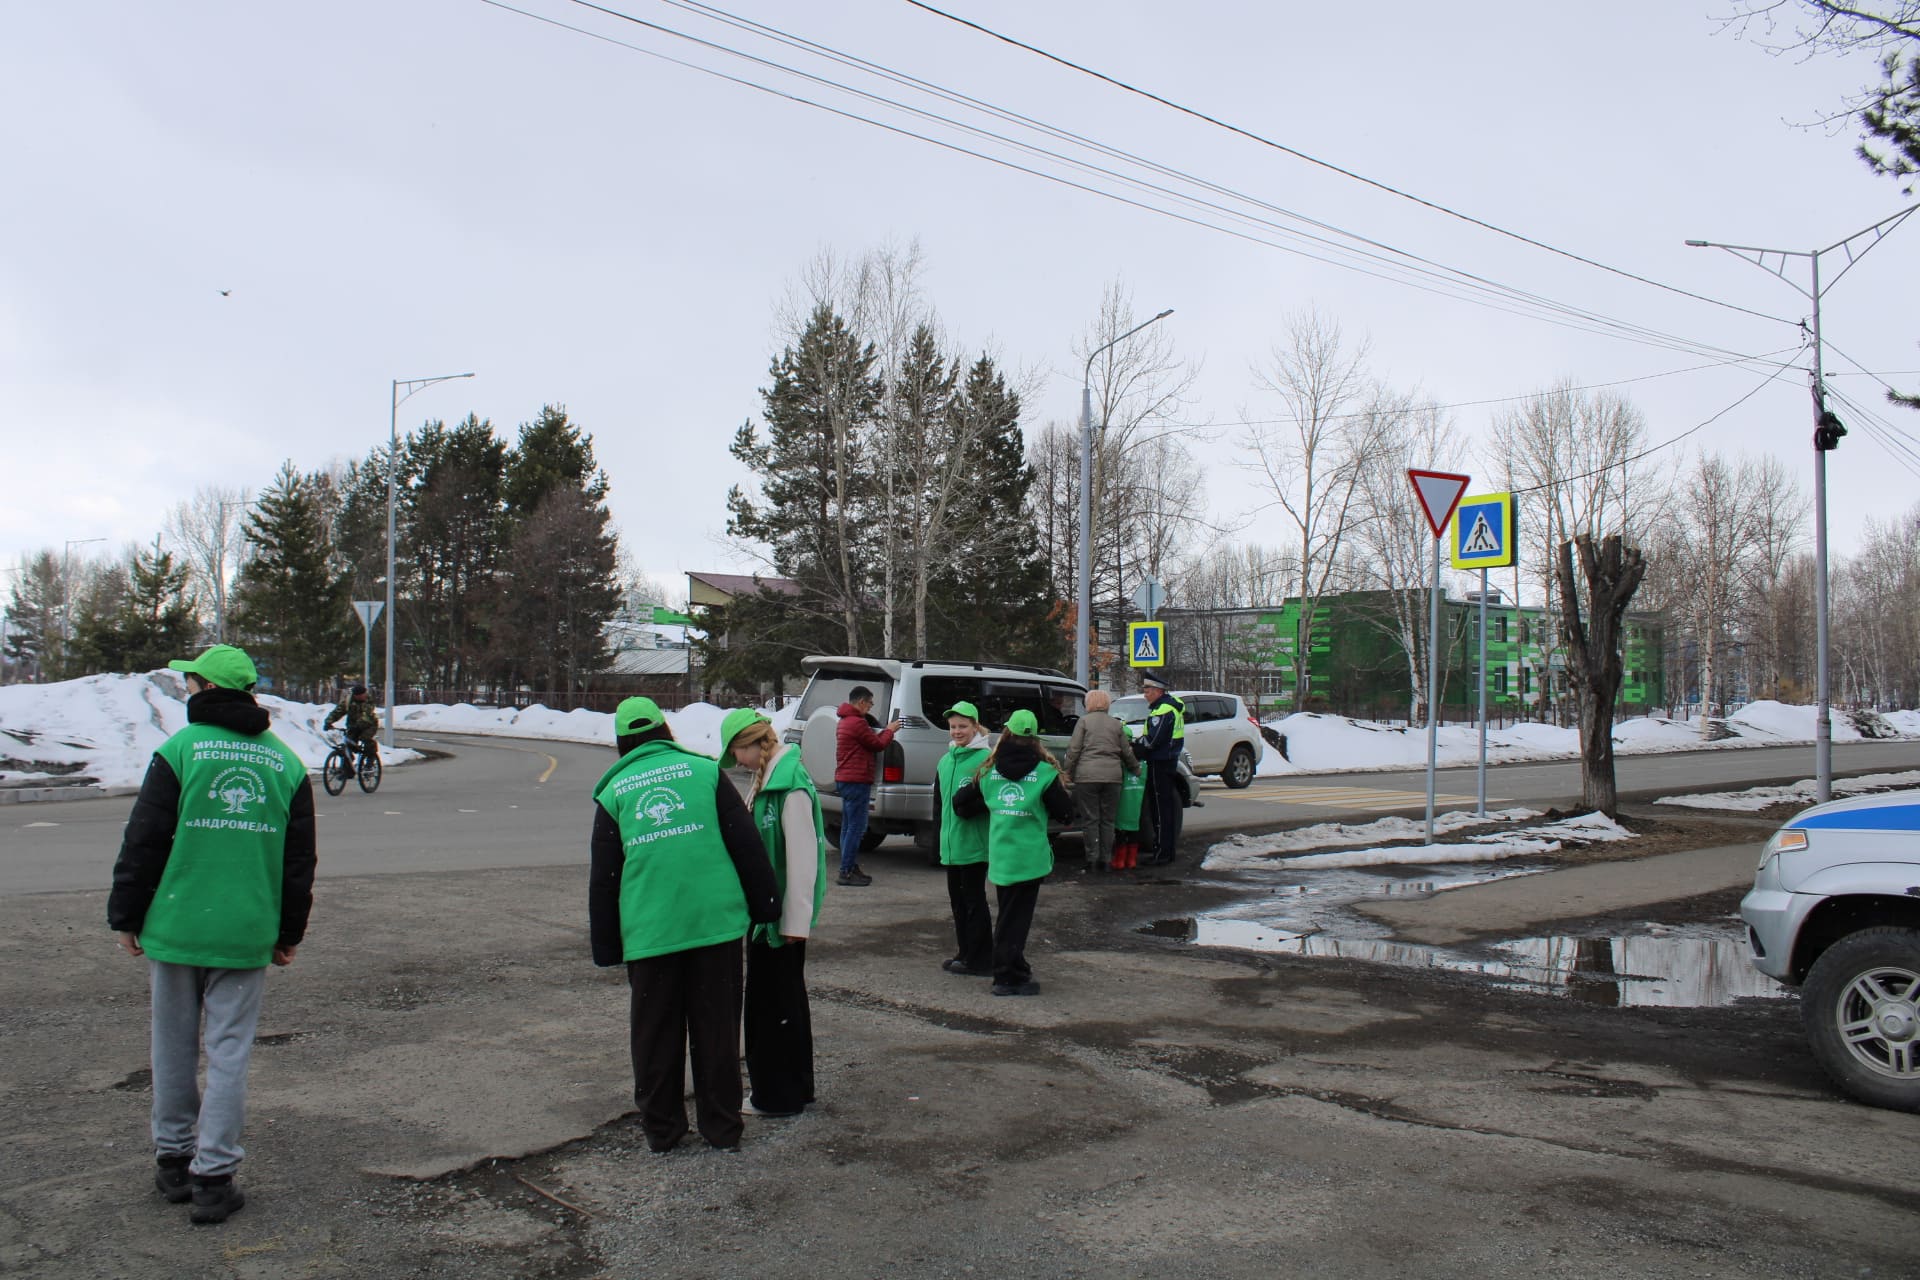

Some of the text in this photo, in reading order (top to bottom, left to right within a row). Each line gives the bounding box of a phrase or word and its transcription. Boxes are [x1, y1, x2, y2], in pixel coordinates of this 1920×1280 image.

[193, 741, 285, 762] МИЛЬКОВСКОЕ
[193, 751, 285, 772] ЛЕСНИЧЕСТВО
[615, 769, 693, 796] ЛЕСНИЧЕСТВО
[185, 818, 277, 832] «АНДРОМЕДА»
